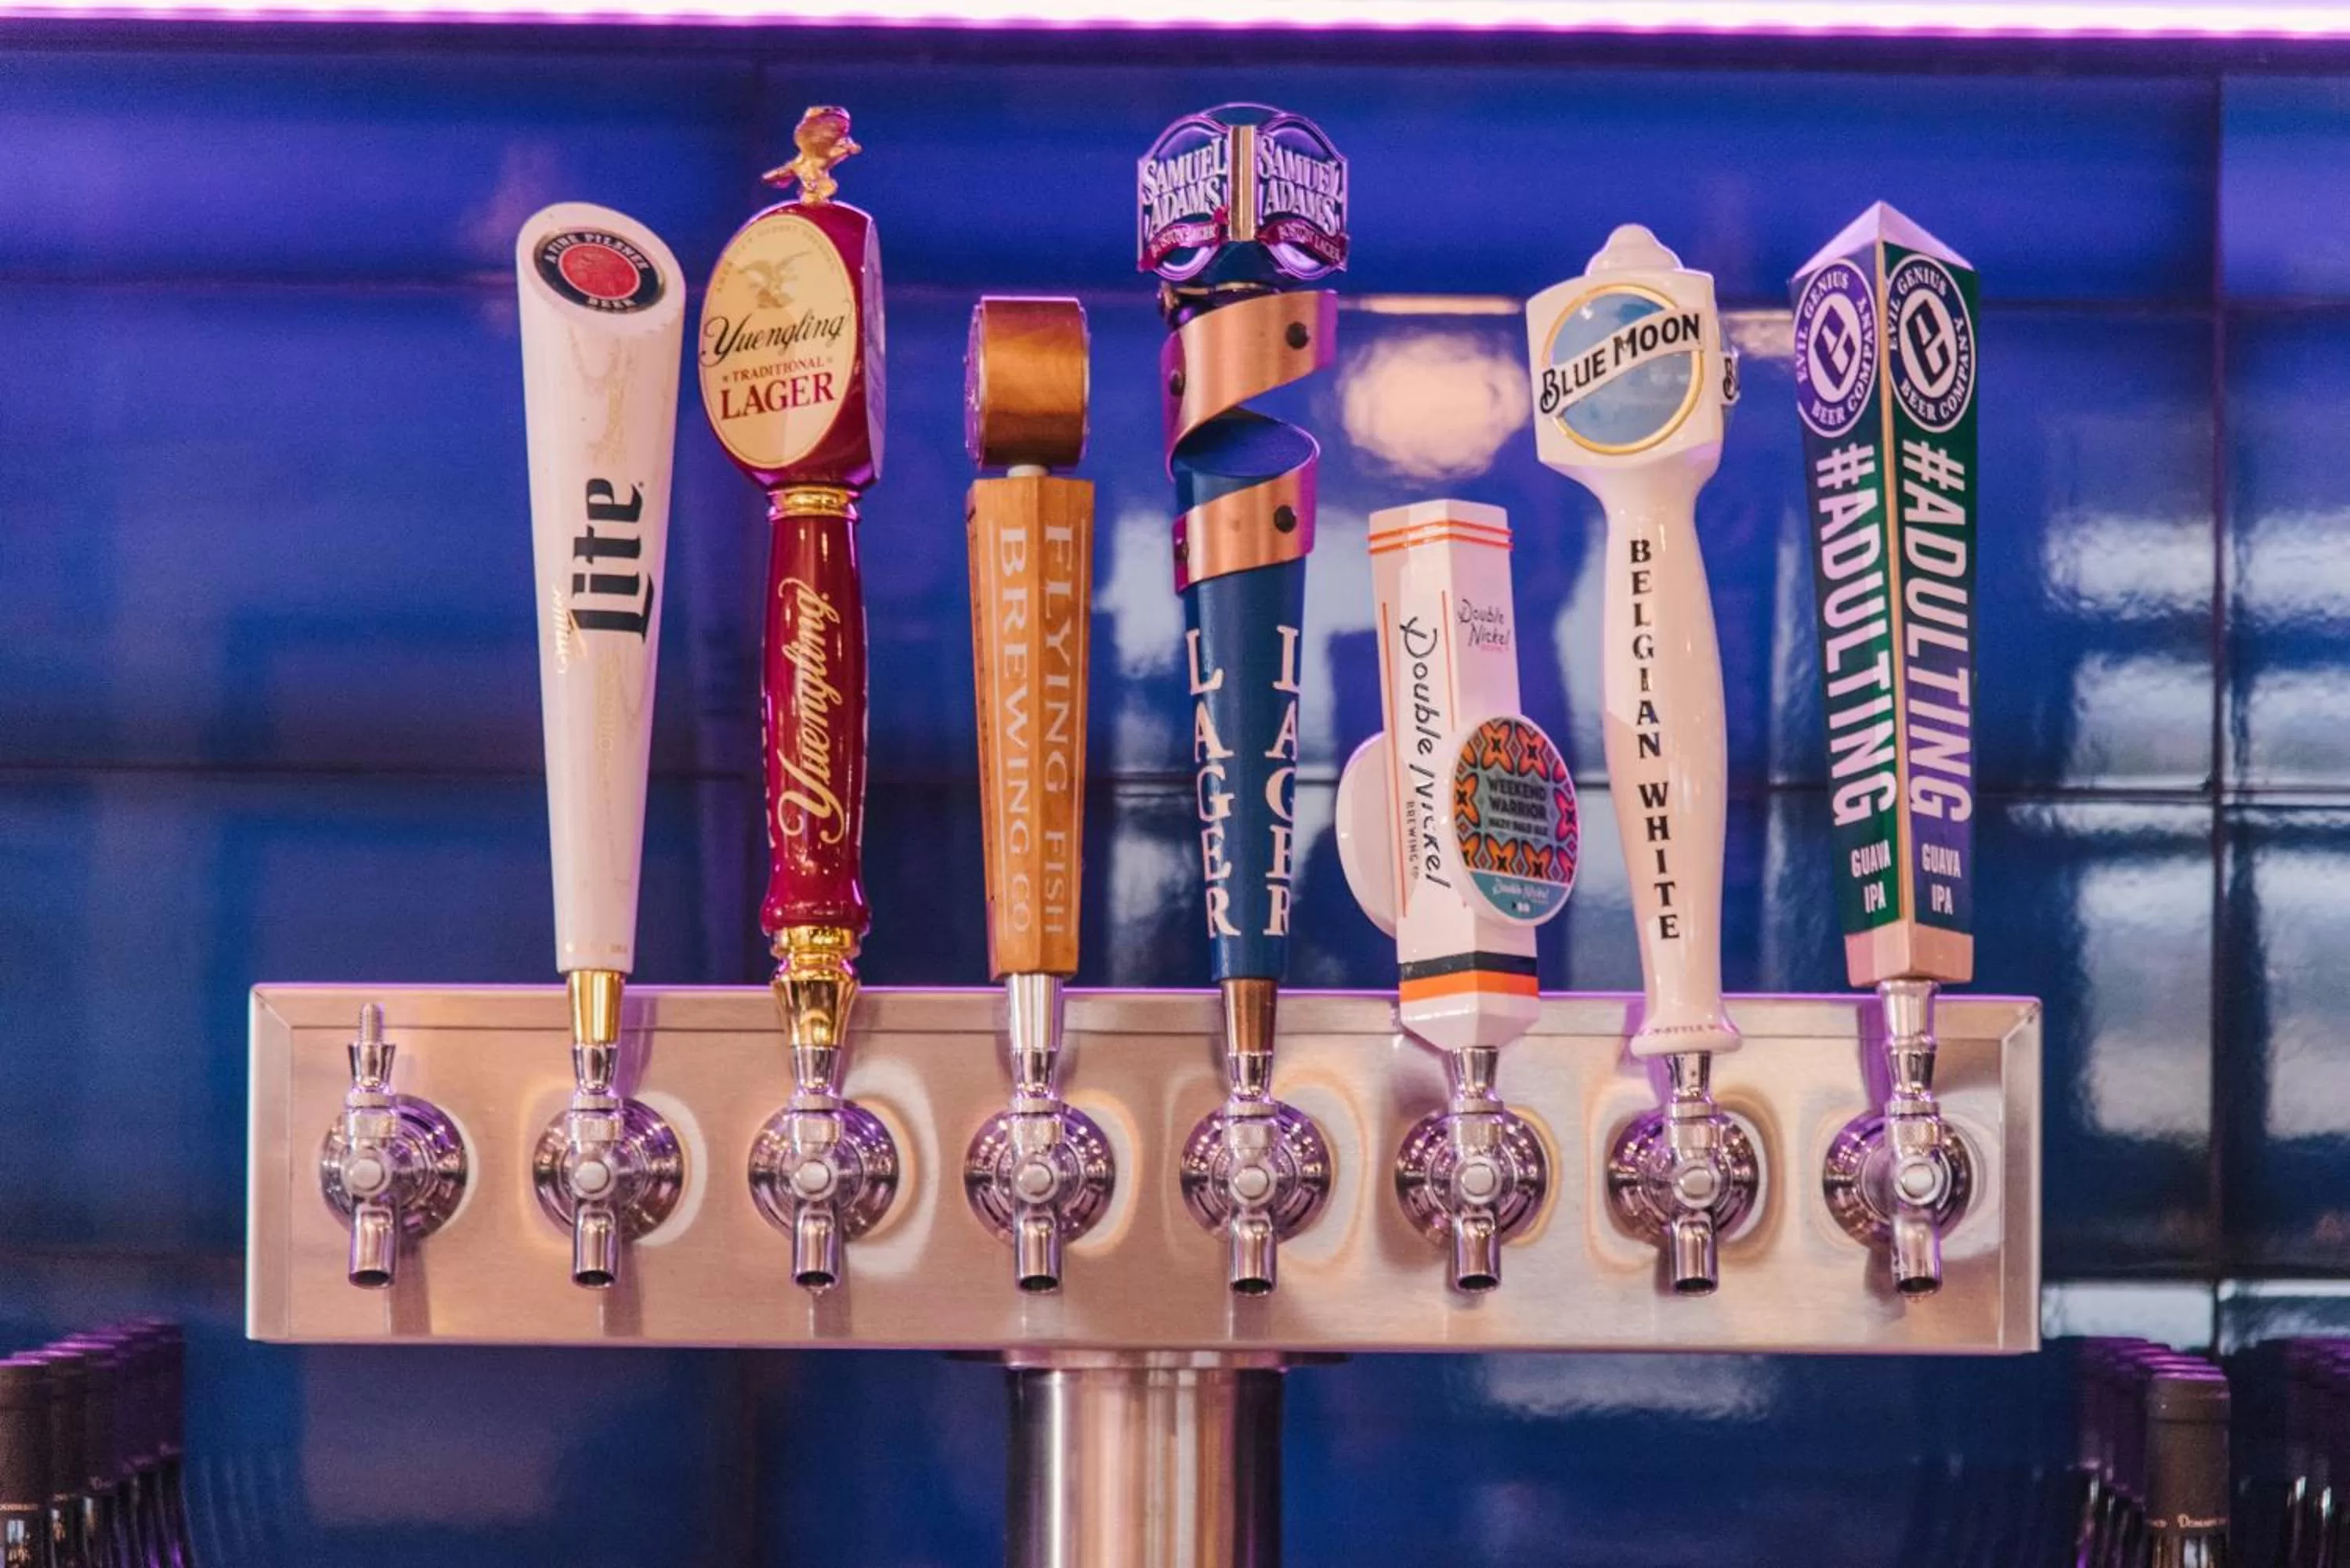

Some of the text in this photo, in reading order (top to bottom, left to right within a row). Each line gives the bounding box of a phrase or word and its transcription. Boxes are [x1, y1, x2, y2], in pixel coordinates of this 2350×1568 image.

[1142, 136, 1227, 204] SAMUEL
[1260, 135, 1344, 204] SAMUEL
[1148, 177, 1222, 240] ADAMS
[1264, 180, 1340, 238] ADAMS
[548, 234, 580, 255] FINE
[586, 233, 650, 269] PILSNER
[699, 301, 852, 368] Yuengling
[1795, 271, 1849, 383] EVIL GENIUS
[1888, 266, 1947, 351] EVIL GENIUS
[732, 356, 825, 382] TRADITIONAL
[1540, 313, 1701, 414] BLUE MOON
[1812, 297, 1874, 426] BEER COMPANY
[1899, 316, 1969, 421] BEER COMPANY
[720, 372, 836, 421] LAGER
[568, 478, 655, 644] Lite
[1457, 598, 1505, 625] Double
[1467, 623, 1511, 646] Nickel
[1816, 443, 1897, 827] #ADULTING
[1903, 439, 1972, 823] #ADULTING
[778, 577, 845, 844] Yuengling
[1000, 526, 1031, 854] BREWING
[1044, 525, 1074, 935] FLYING FISH
[1400, 616, 1452, 889] Double Nickel
[1629, 540, 1681, 941] BELGIAN WHITE
[1185, 628, 1241, 939] LAGER
[1487, 776, 1546, 803] WEEKEND
[1488, 796, 1547, 820] WARRIOR
[1850, 839, 1893, 880] GUAVA
[1921, 843, 1962, 879] GUAVA
[1864, 880, 1887, 915] IPA
[1931, 883, 1954, 916] IPA
